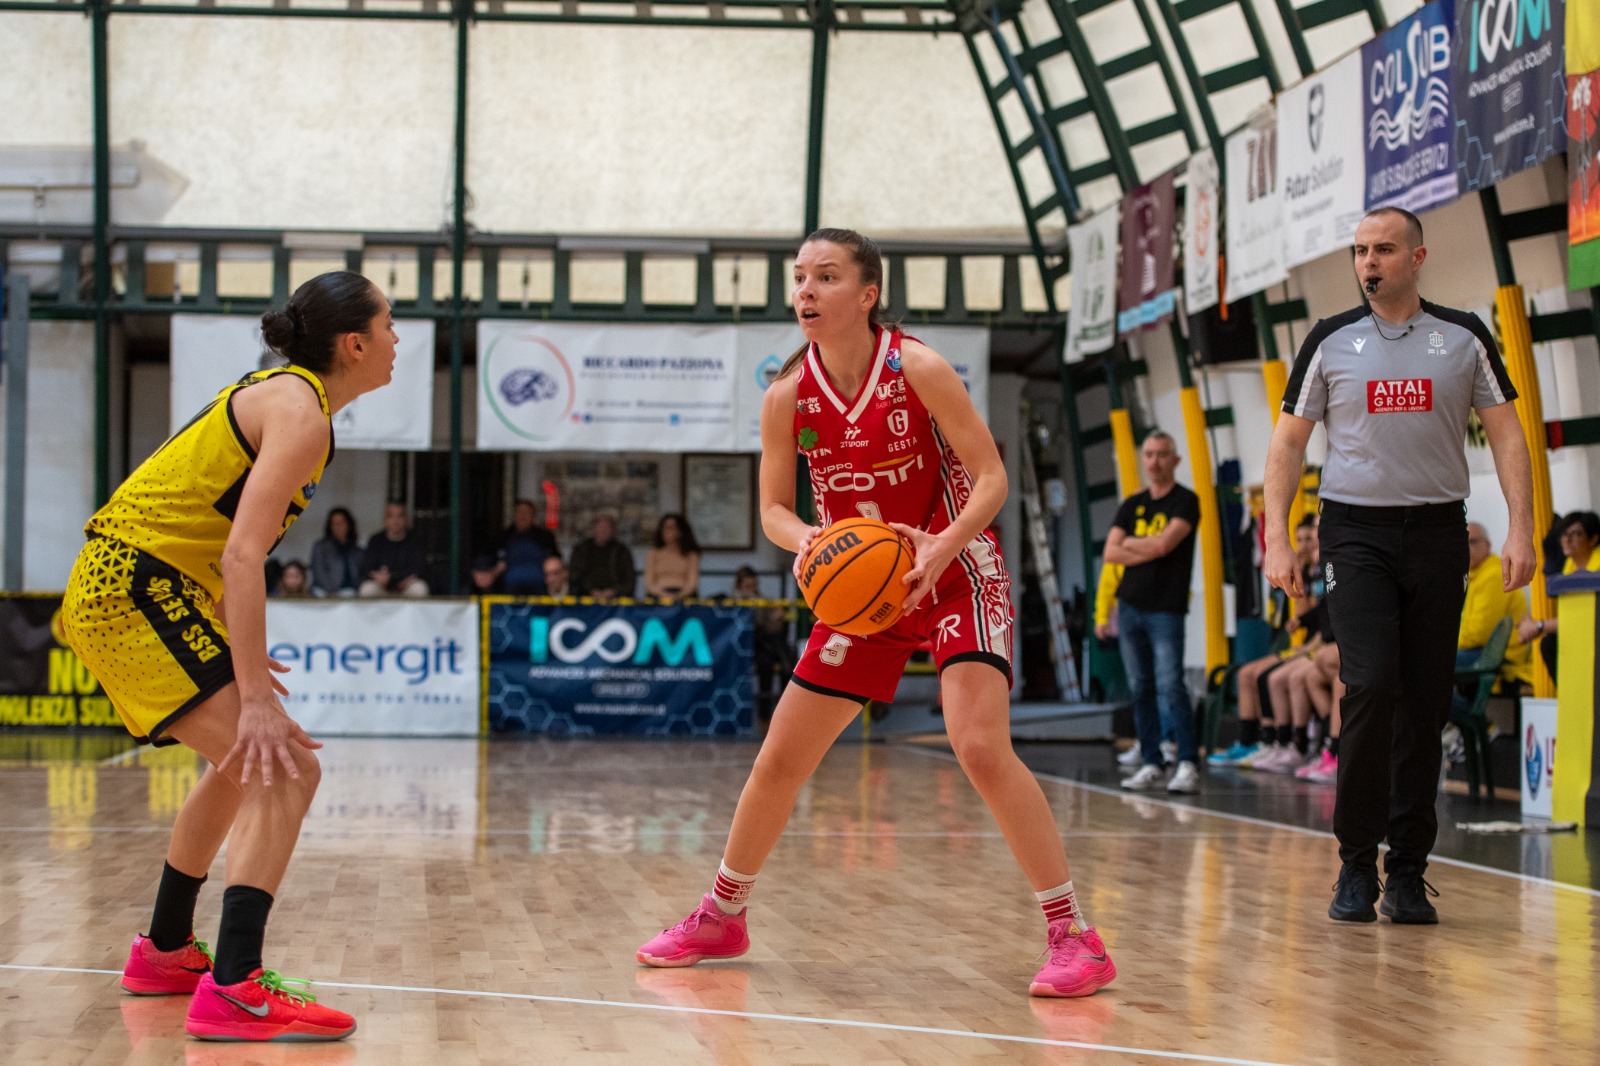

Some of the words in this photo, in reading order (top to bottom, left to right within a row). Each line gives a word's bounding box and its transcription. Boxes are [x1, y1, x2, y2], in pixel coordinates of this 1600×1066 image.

[1370, 19, 1450, 105] COLSUB
[1428, 348, 1447, 356] FIP
[1374, 379, 1426, 396] ATTAL
[1373, 395, 1427, 407] GROUP
[887, 436, 918, 452] GESTA
[803, 531, 863, 589] Wilson
[869, 602, 893, 623] FIBA
[530, 616, 713, 667] ICOM
[267, 637, 463, 686] energit
